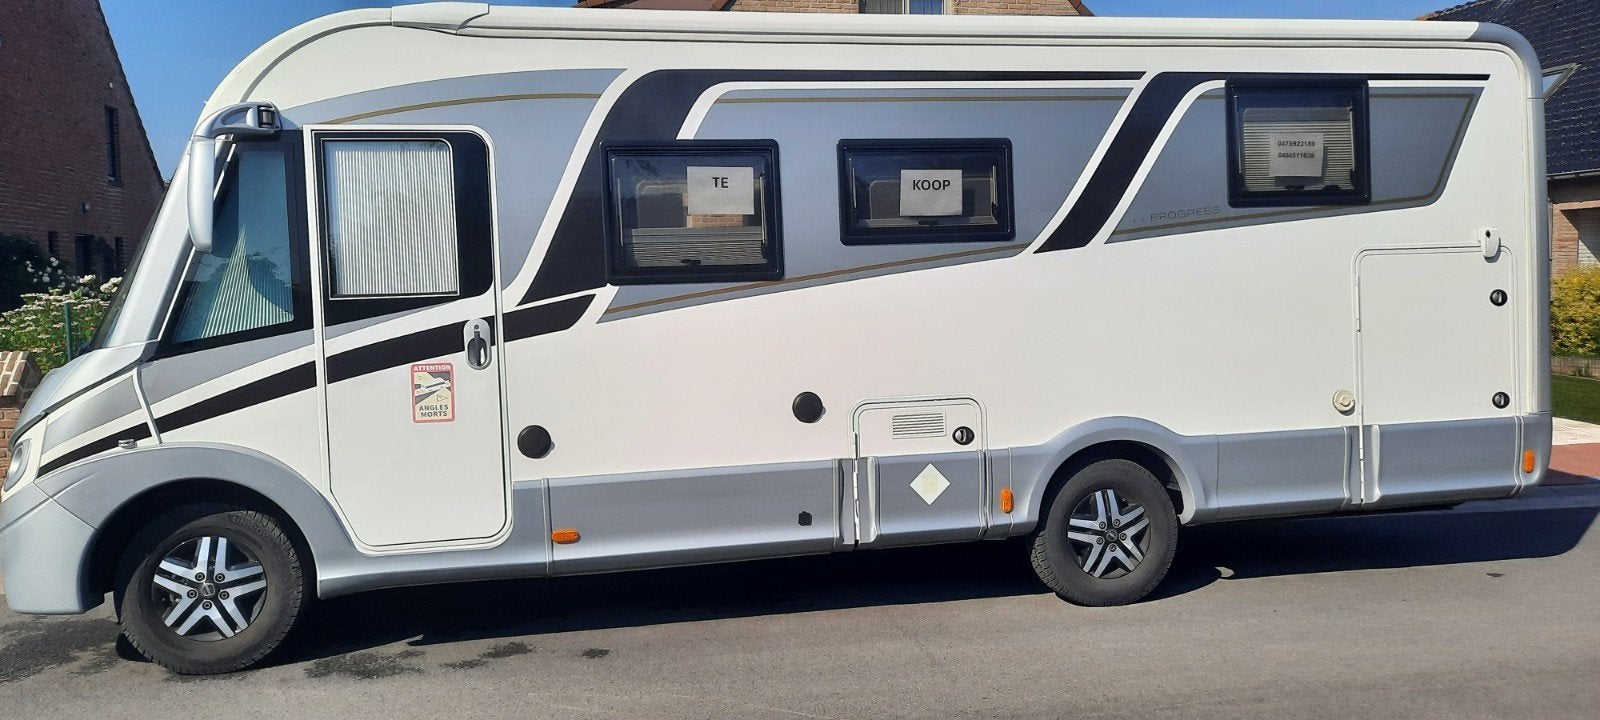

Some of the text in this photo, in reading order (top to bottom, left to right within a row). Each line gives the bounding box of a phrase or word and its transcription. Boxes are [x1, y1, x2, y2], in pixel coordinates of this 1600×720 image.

[712, 177, 729, 189] TE
[912, 179, 951, 191] KOOP
[1150, 205, 1221, 221] PROGRESS
